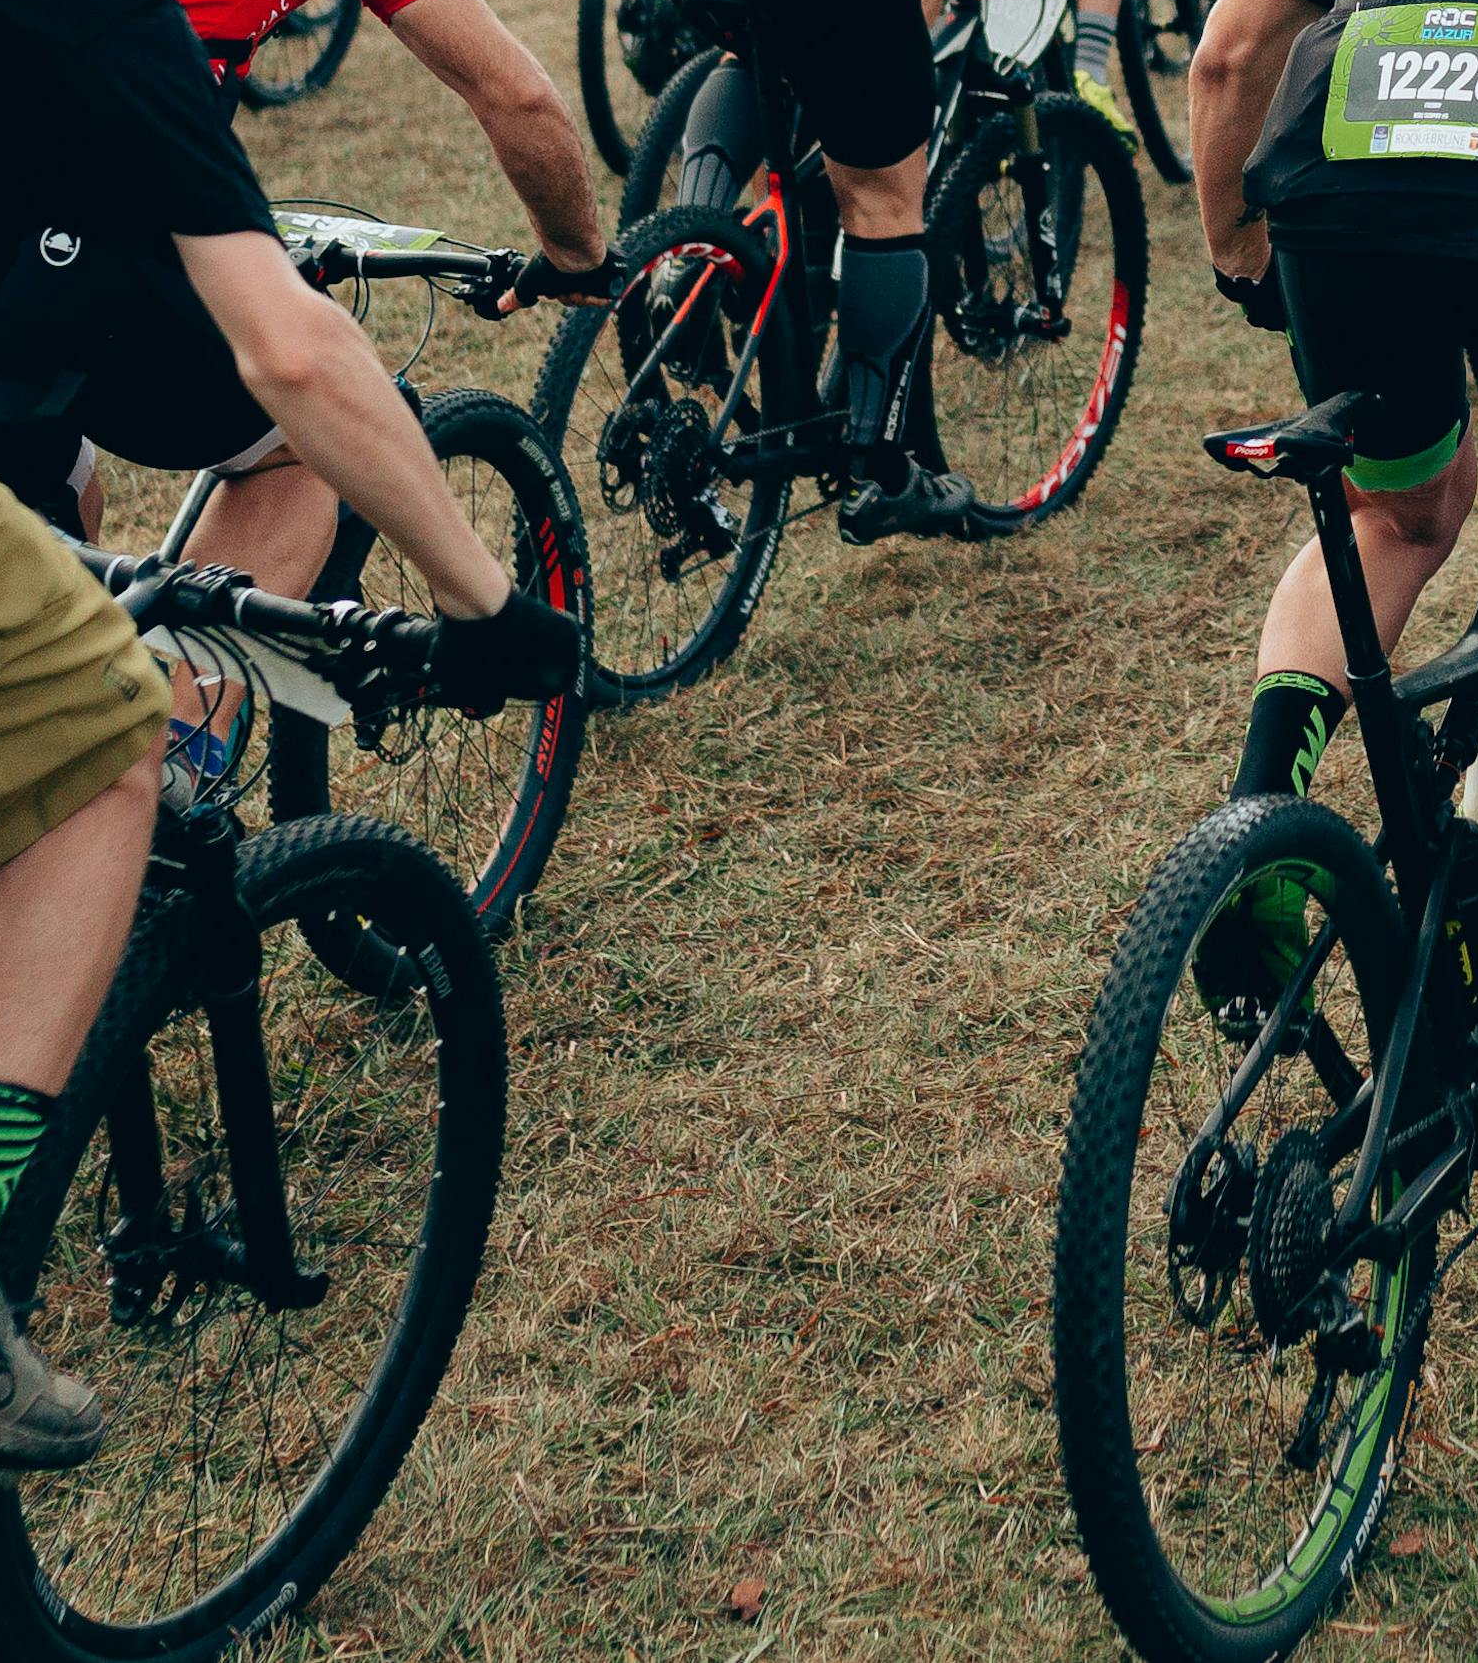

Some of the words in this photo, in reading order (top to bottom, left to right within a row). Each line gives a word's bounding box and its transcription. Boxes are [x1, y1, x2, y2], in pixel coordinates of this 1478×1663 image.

[1425, 8, 1478, 26] ROC
[1421, 27, 1474, 41] D'AZUR
[1394, 131, 1467, 148] ROQUEBRUNE
